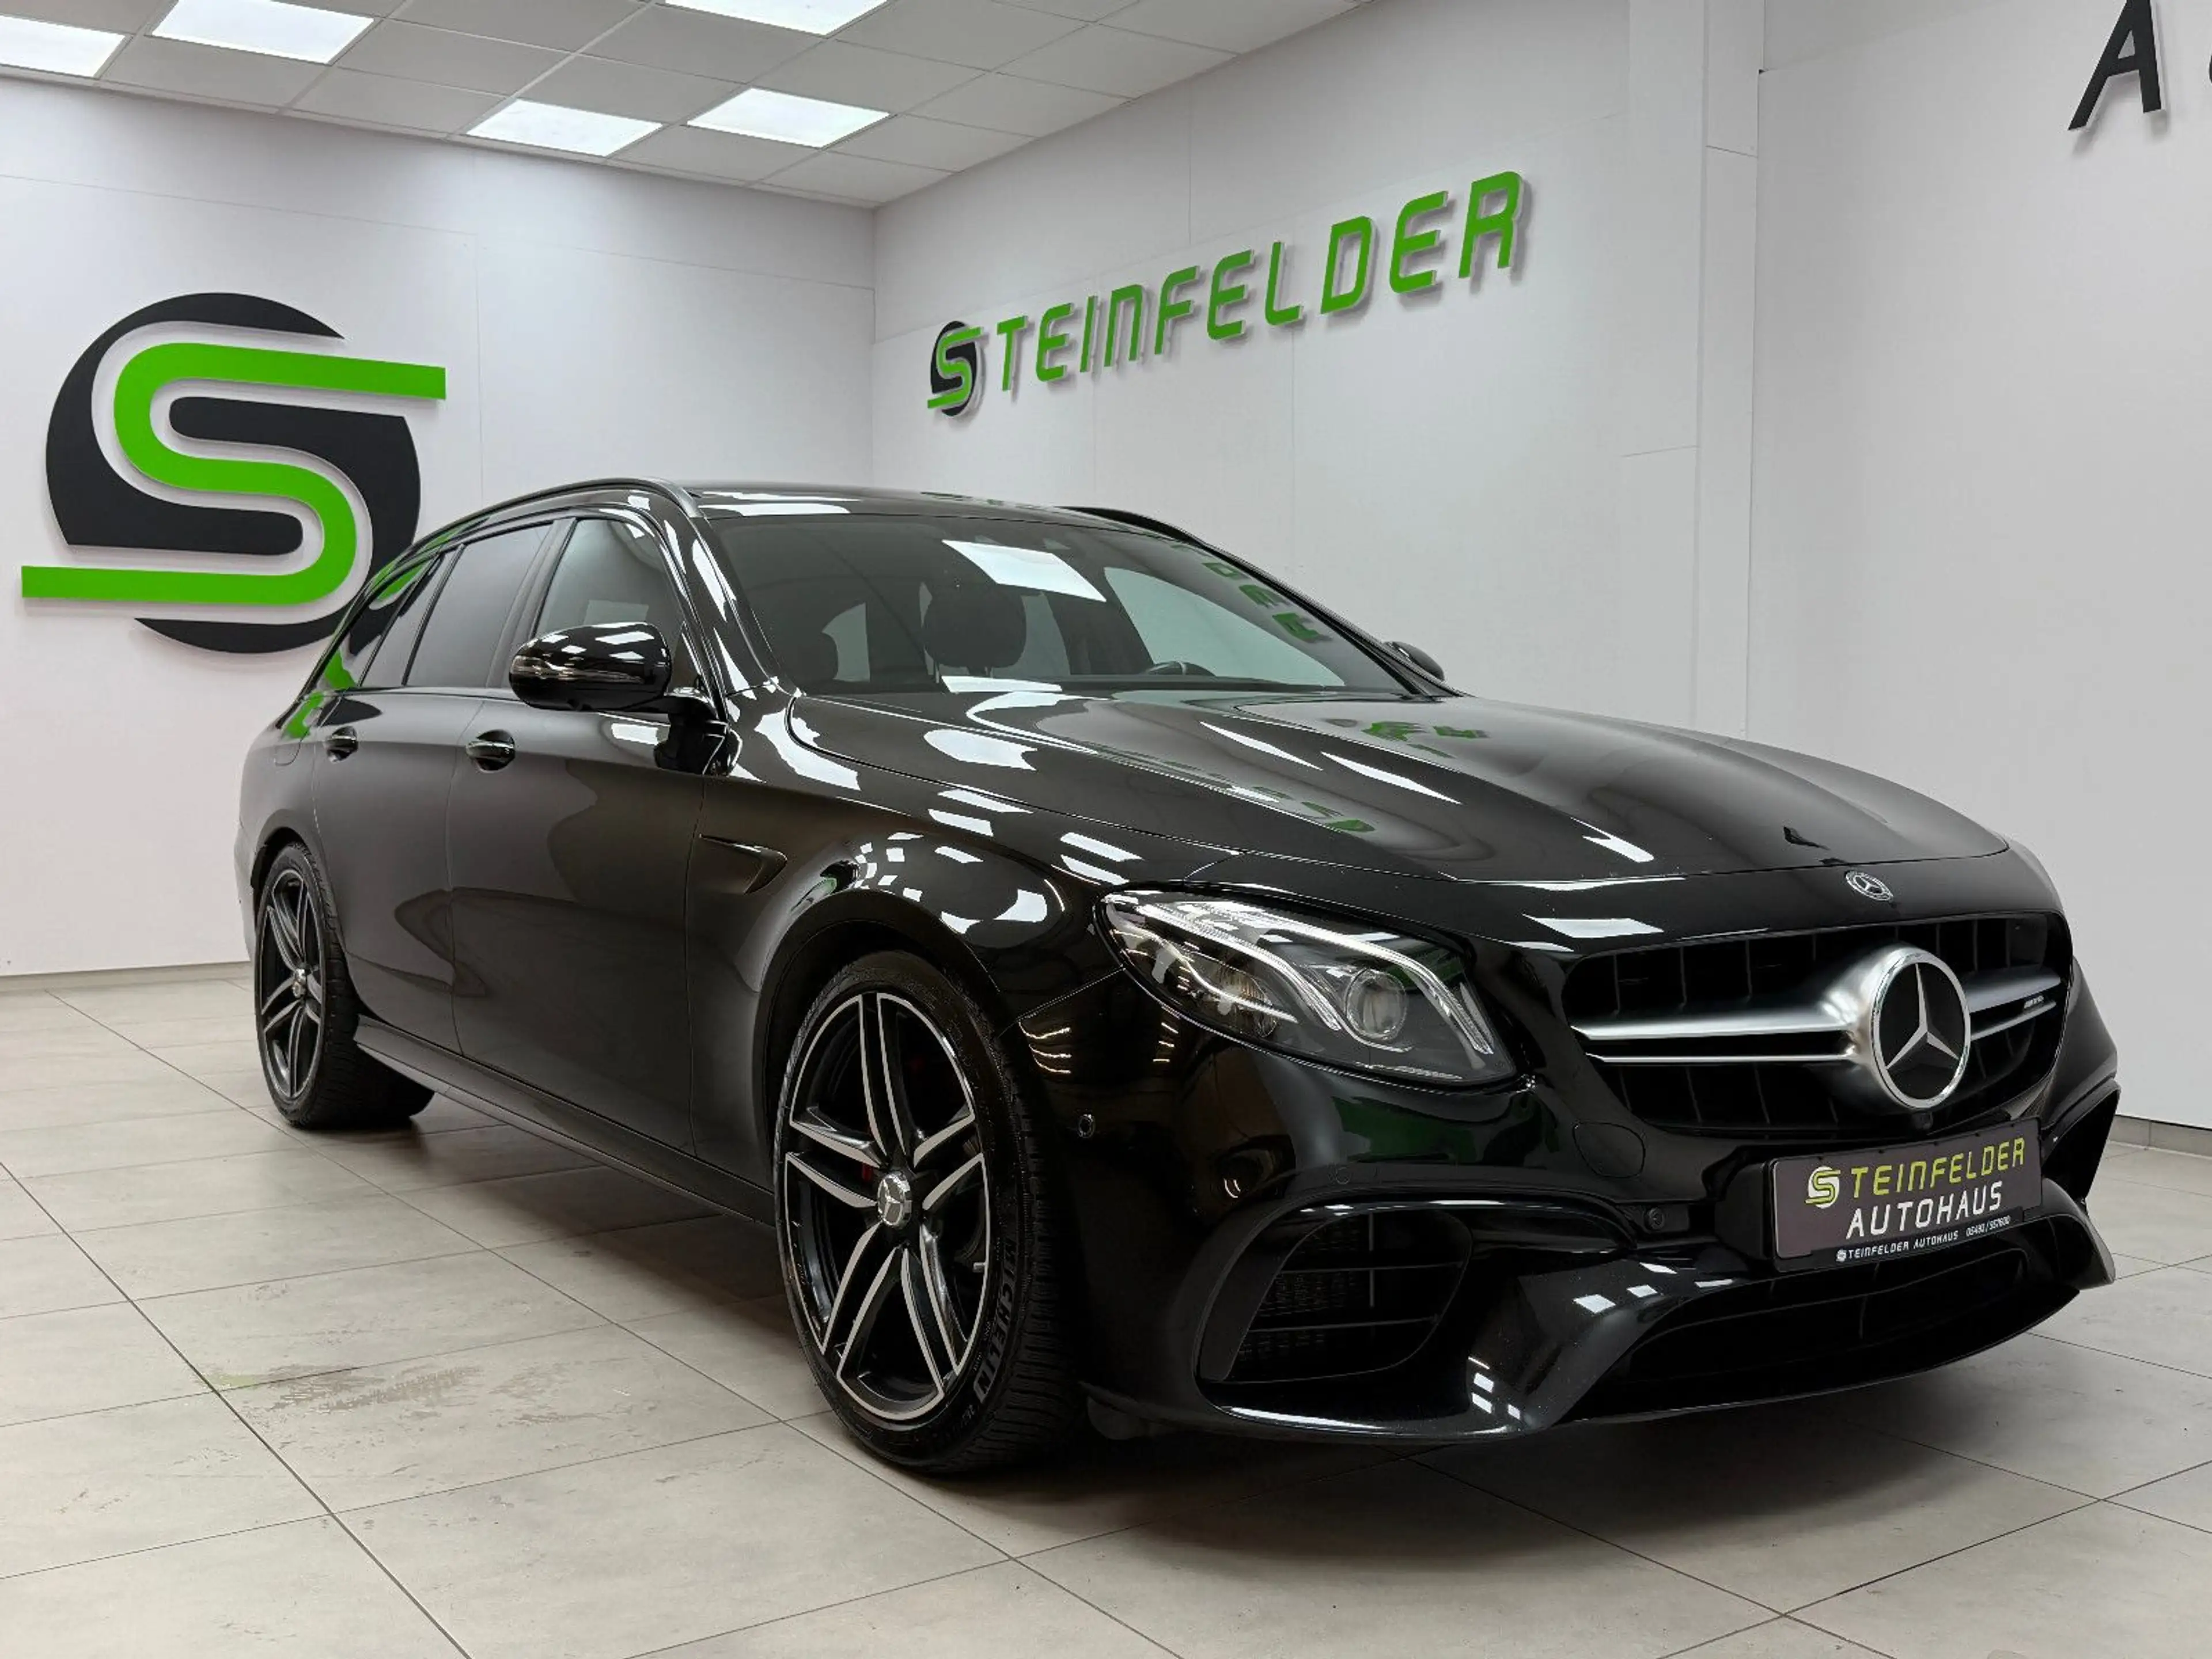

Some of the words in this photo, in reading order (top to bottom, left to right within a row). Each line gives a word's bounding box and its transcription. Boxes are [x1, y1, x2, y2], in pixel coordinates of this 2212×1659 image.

[2068, 0, 2212, 130] A
[927, 171, 1522, 414] STEINFELDER
[21, 342, 446, 607] S
[1805, 1137, 2025, 1205] STEINFELDER
[1845, 1180, 2003, 1240] AUTOHAUS
[1914, 1230, 1959, 1249] AUTOHAUS
[974, 1236, 1018, 1404] MICHELIN
